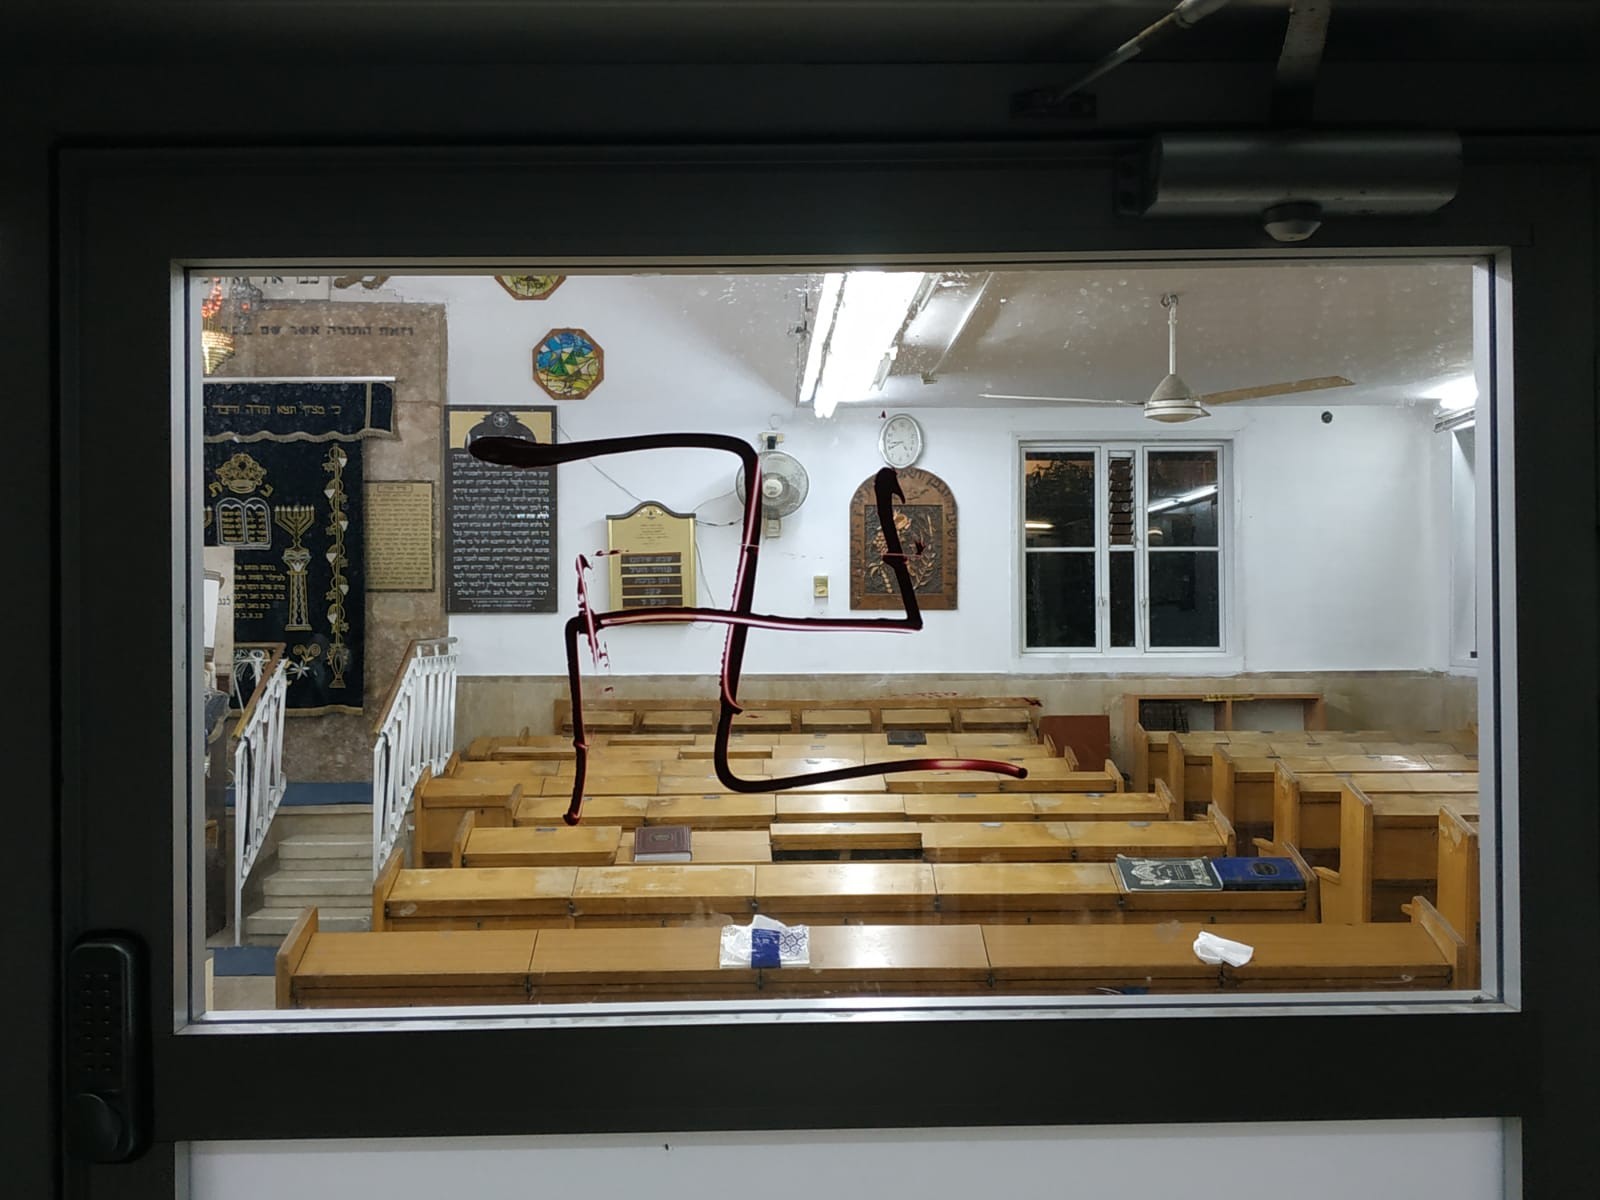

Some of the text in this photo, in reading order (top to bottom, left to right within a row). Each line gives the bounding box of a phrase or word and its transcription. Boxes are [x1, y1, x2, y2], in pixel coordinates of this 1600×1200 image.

[260, 325, 281, 336] שם
[289, 325, 322, 337] אשר
[326, 325, 373, 336] התורה
